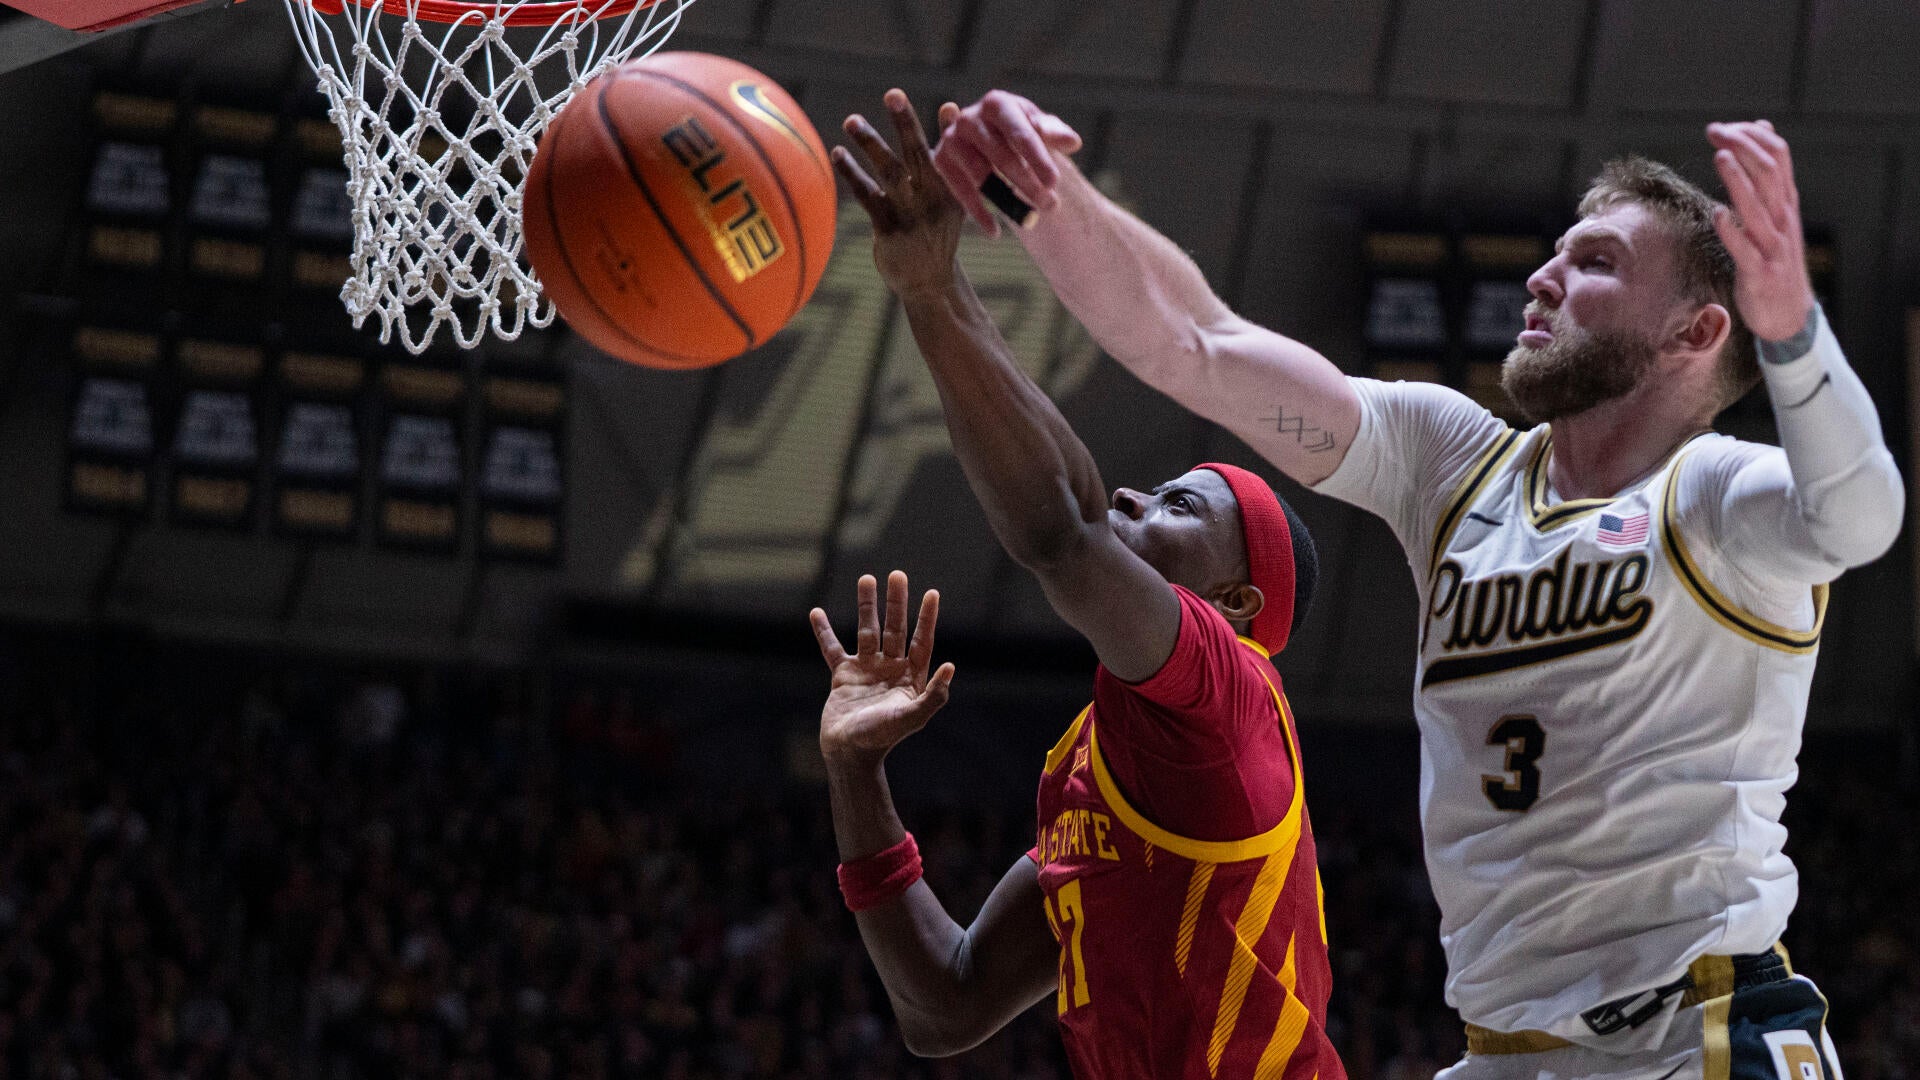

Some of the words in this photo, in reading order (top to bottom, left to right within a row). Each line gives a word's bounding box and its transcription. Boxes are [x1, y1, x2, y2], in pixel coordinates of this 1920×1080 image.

[660, 116, 784, 272] ELITE
[1421, 542, 1654, 655] Purdue
[1481, 713, 1547, 813] 3
[1050, 809, 1121, 861] STATE
